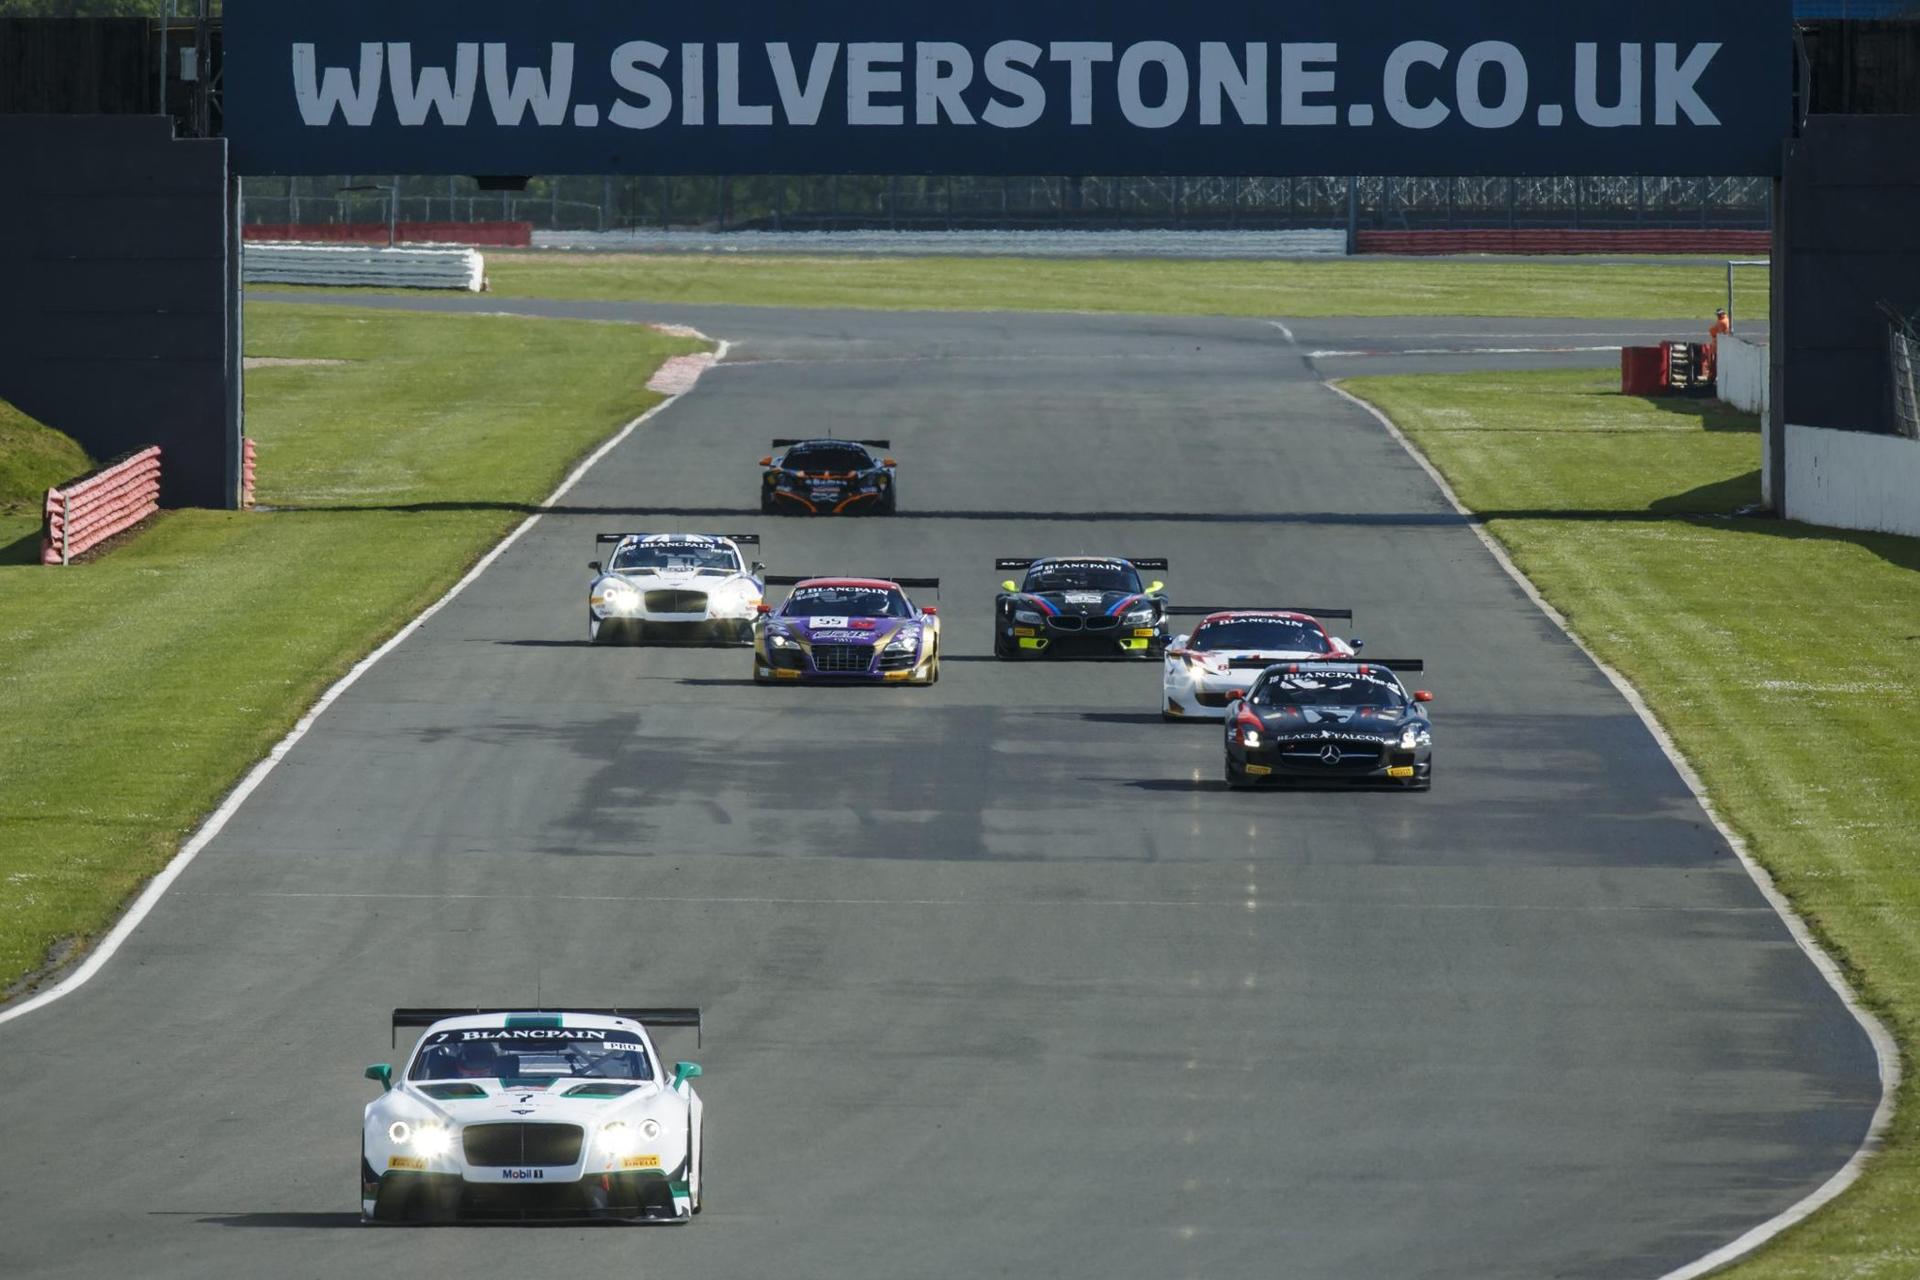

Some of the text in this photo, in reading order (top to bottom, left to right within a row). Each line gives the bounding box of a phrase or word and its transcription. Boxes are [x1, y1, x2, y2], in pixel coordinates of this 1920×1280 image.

[292, 40, 1722, 129] WWW.SILVERSTONE.CO.UK
[639, 541, 716, 549] BLANCPAIN
[1044, 563, 1122, 571] BLANCPAIN
[807, 586, 888, 595] BLANCPAIN
[1219, 618, 1303, 627] BLANCPAIN
[1283, 671, 1375, 682] BLANCPAIN
[1277, 732, 1321, 742] BLACK
[1334, 733, 1385, 743] FALCON
[462, 1030, 607, 1041] BLANCPAIN
[502, 1169, 533, 1180] Mobil
